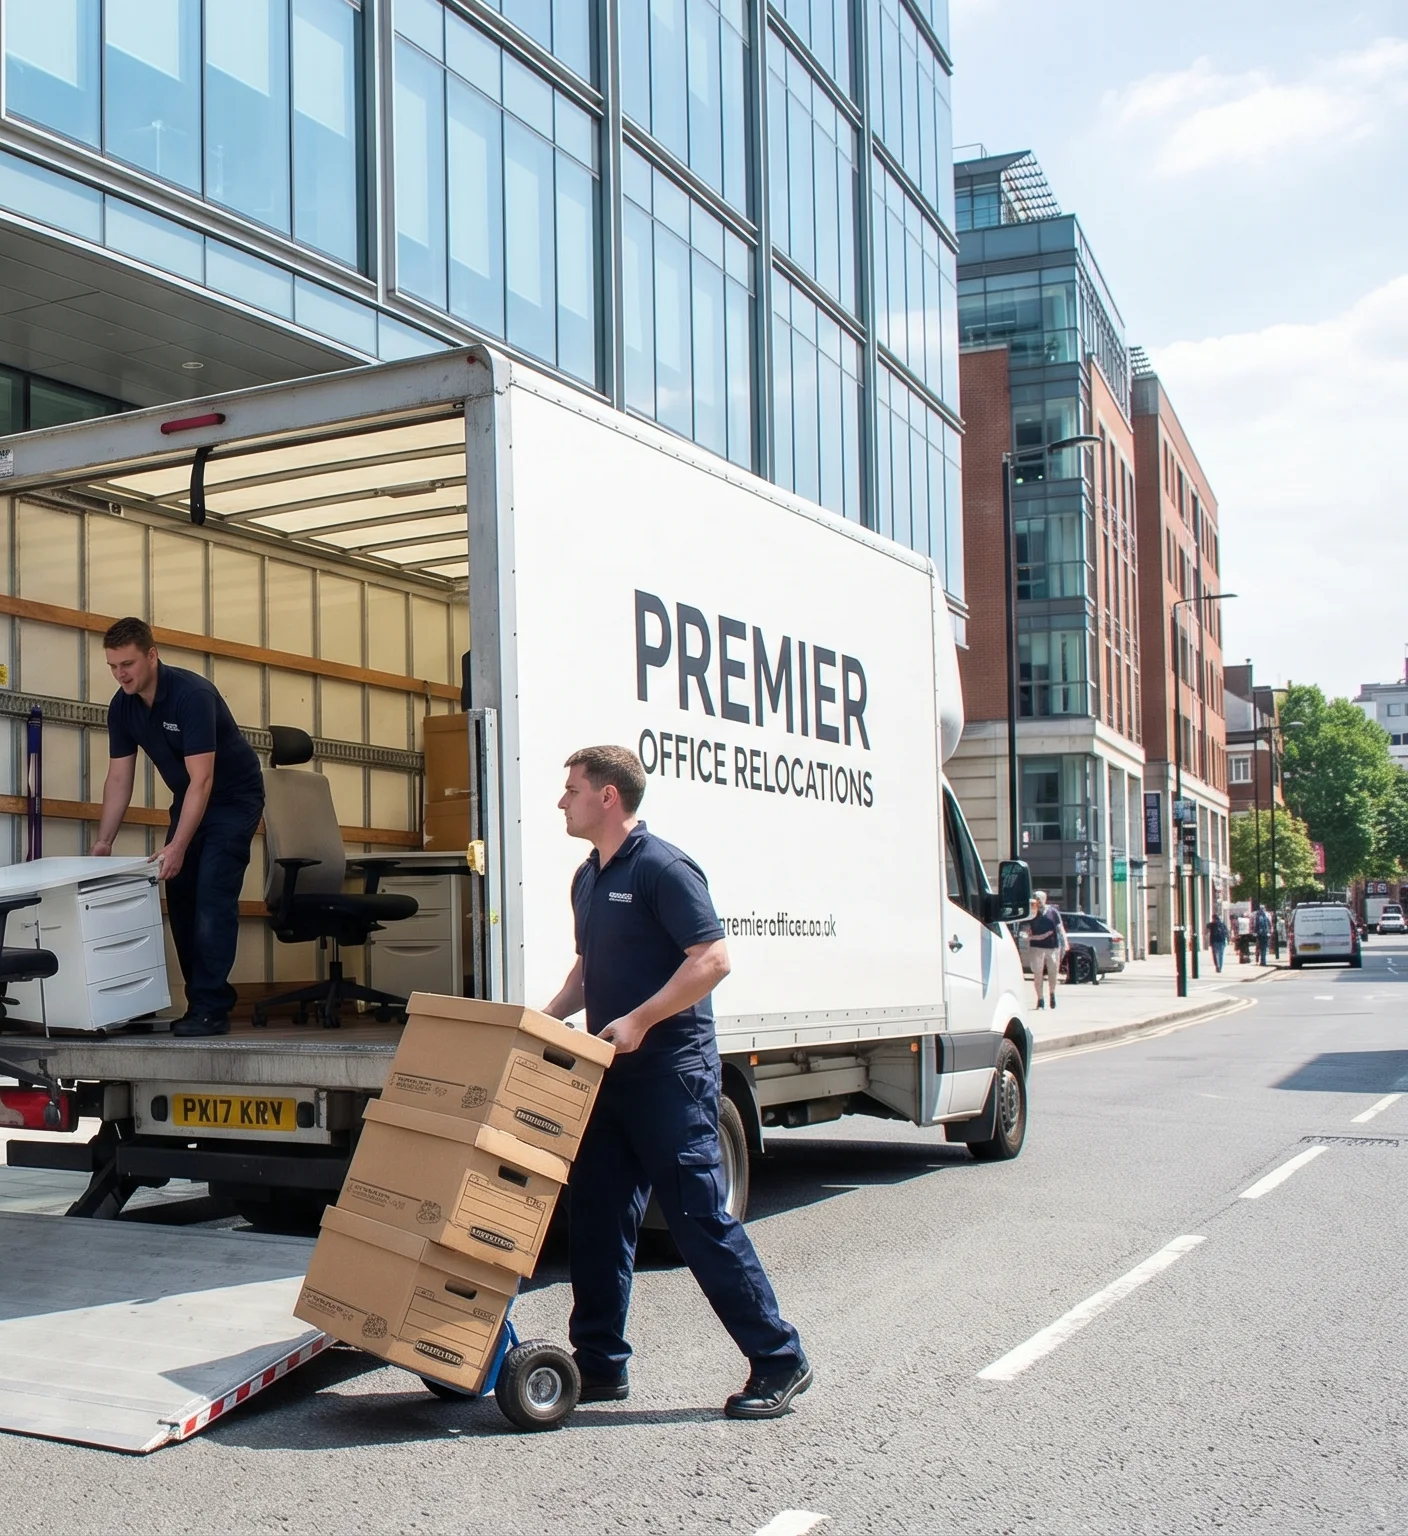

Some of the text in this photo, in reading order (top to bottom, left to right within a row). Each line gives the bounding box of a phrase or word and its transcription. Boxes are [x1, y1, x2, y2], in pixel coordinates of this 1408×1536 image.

[634, 588, 871, 751] PREMIER
[638, 728, 875, 808] OFFICE RELOCATIONS
[182, 1097, 233, 1124] PX17
